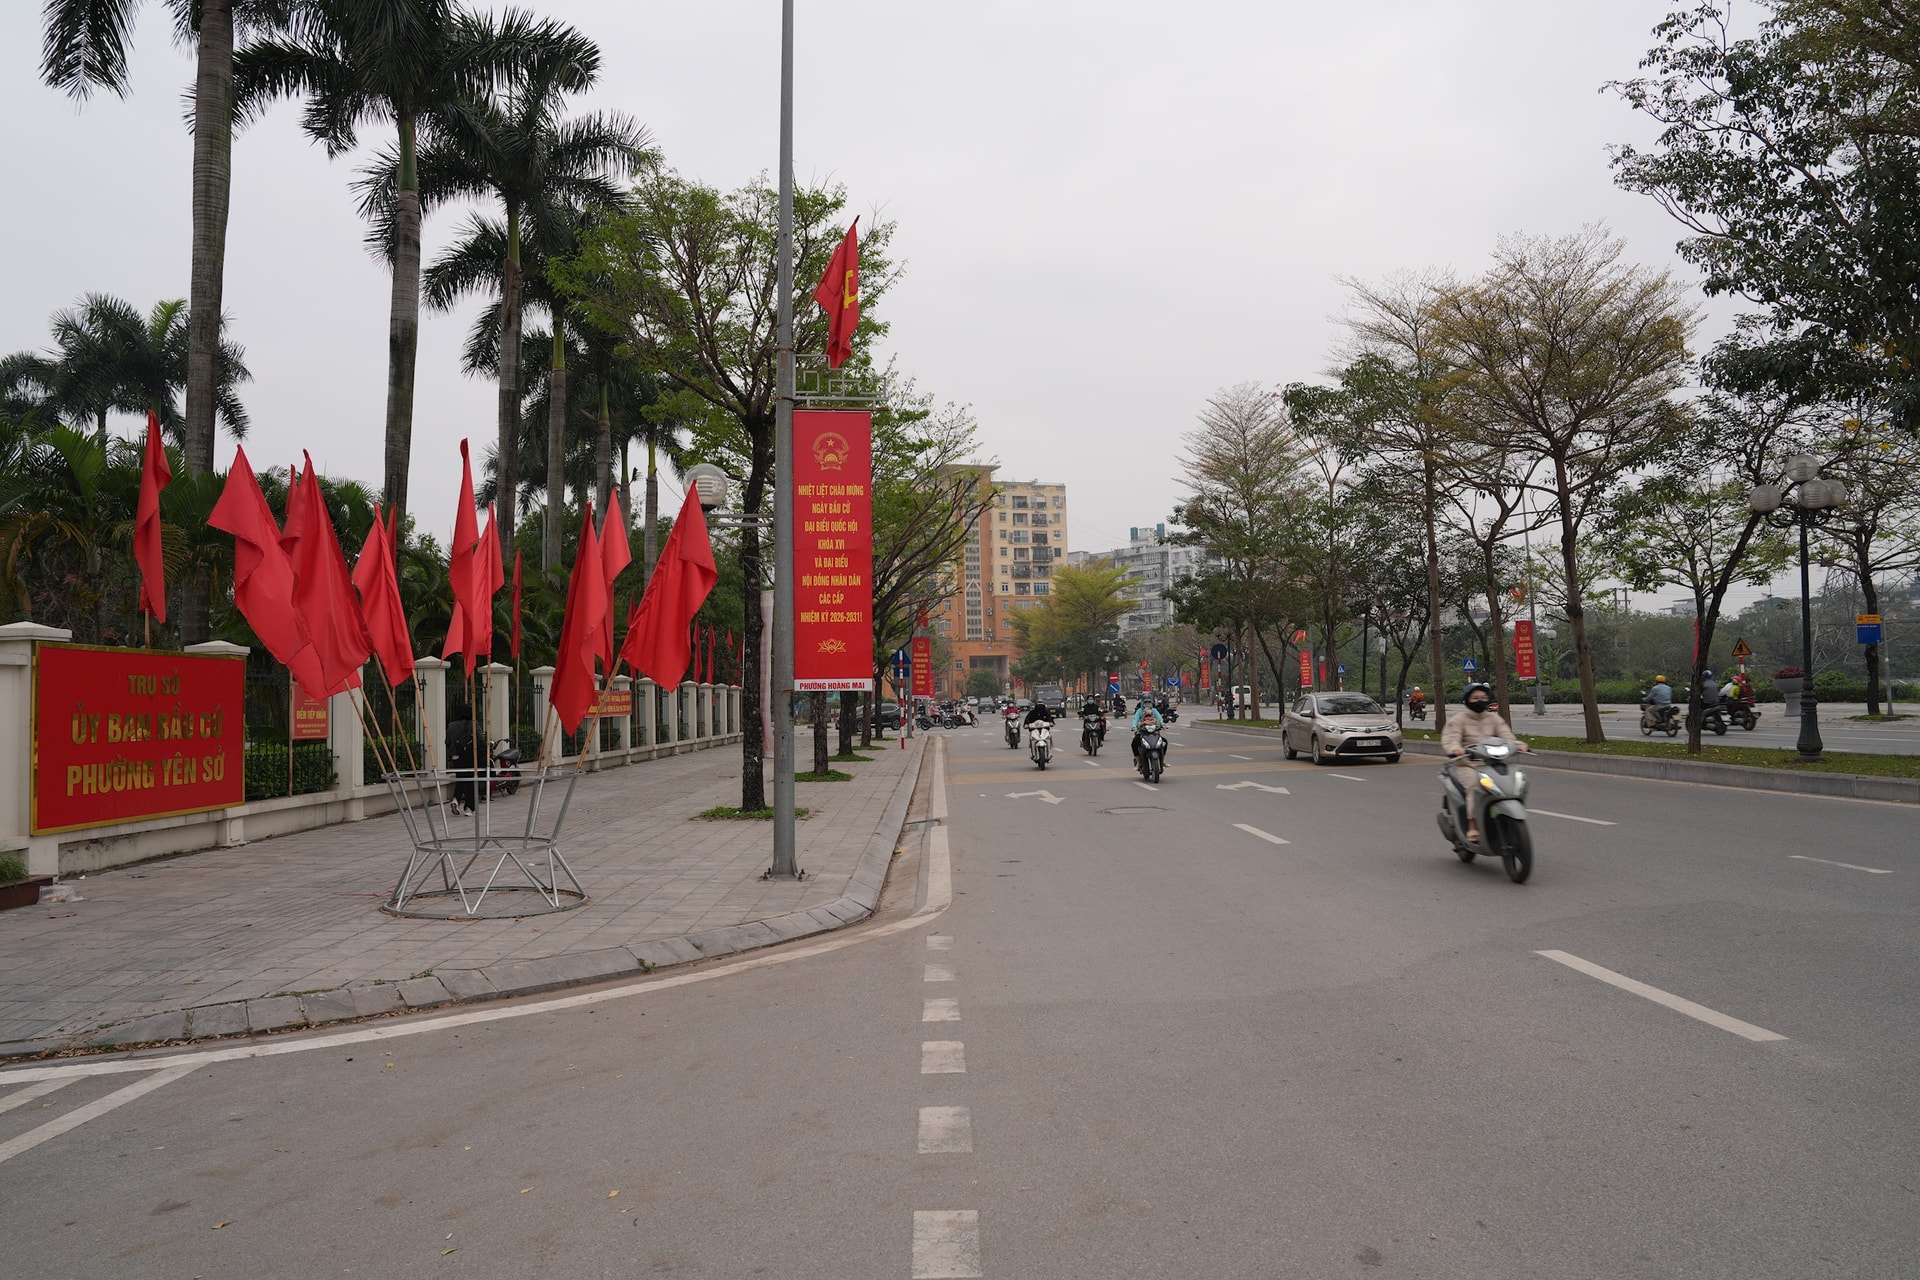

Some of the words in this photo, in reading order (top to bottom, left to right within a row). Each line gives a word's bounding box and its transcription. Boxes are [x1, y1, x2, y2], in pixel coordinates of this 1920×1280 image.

[798, 483, 815, 498] NHIỆT
[816, 483, 828, 498] LIỆT
[829, 483, 845, 496] CHÀO
[846, 483, 864, 496] MỪNG
[812, 501, 828, 514] NGÀY
[842, 500, 851, 514] CỬ
[804, 521, 815, 534] ĐẠI
[816, 517, 830, 532] BIỂU
[831, 518, 847, 533] QUỐC
[848, 519, 858, 534] HỘI
[818, 537, 834, 550] KHÓA
[835, 539, 845, 550] XVI
[815, 555, 823, 568] VÀ
[823, 557, 834, 570] ĐẠI
[835, 553, 849, 568] BIỂU
[802, 573, 813, 588] HỘI
[831, 573, 848, 586] NHÂN
[849, 573, 861, 586] DÂN
[819, 592, 832, 604] CÁC
[832, 590, 845, 604] CẤP
[801, 609, 820, 625] NHIỆM
[830, 611, 863, 623] 2026-2031!
[128, 675, 157, 700] TRỤ
[161, 668, 180, 695] SỞ
[800, 682, 826, 690] PHƯỜNG
[828, 681, 850, 690] HOÀNG
[71, 702, 100, 744] ỦY
[108, 713, 150, 743] BAN
[157, 702, 194, 741] BẦU
[200, 703, 224, 739] CỬ
[66, 754, 155, 797] PHƯỜNG
[161, 752, 196, 787] YÊN
[202, 745, 225, 783] SỞ
